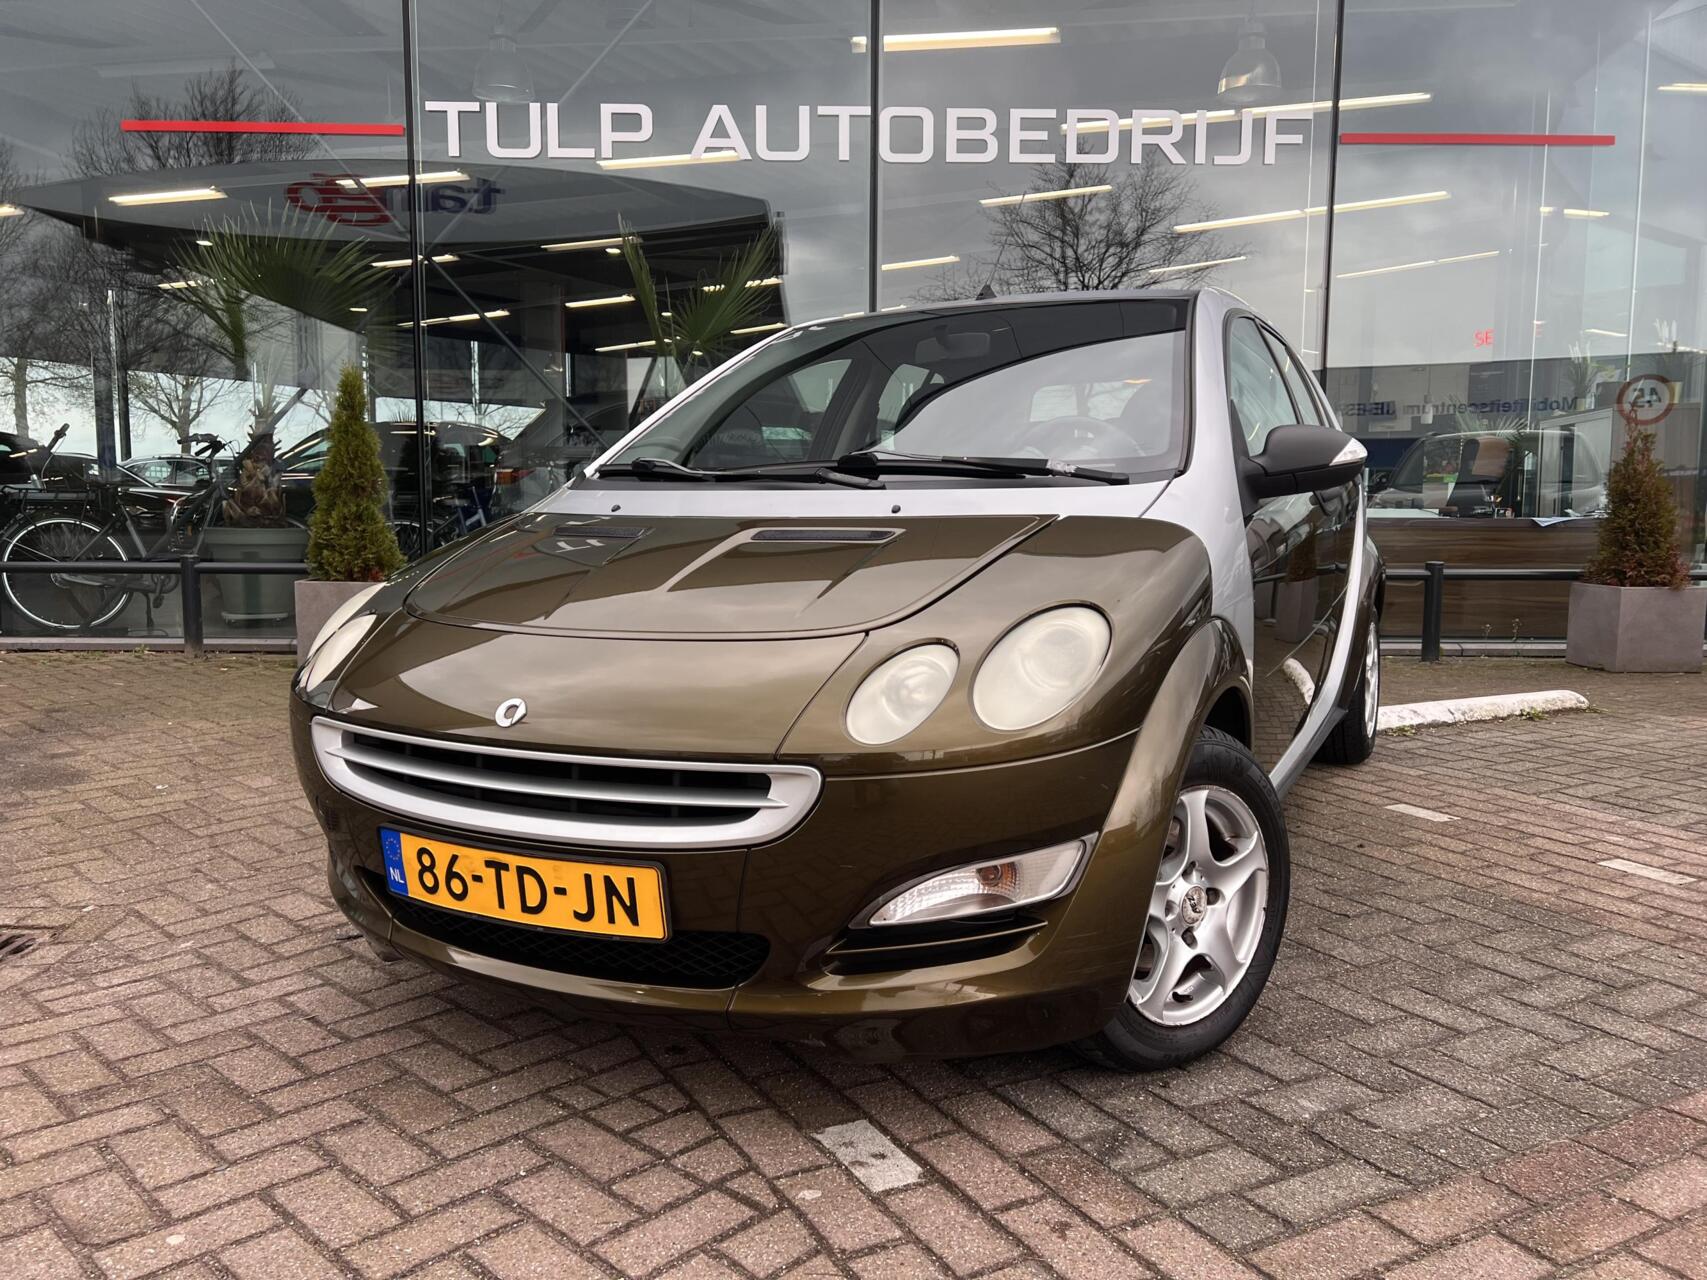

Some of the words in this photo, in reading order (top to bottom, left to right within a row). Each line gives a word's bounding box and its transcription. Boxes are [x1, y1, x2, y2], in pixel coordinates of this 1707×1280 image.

[424, 101, 654, 159] TULP
[690, 104, 1314, 165] AUTOBEDRIJF
[389, 867, 406, 884] NL
[416, 846, 640, 927] 86-TD-JN
